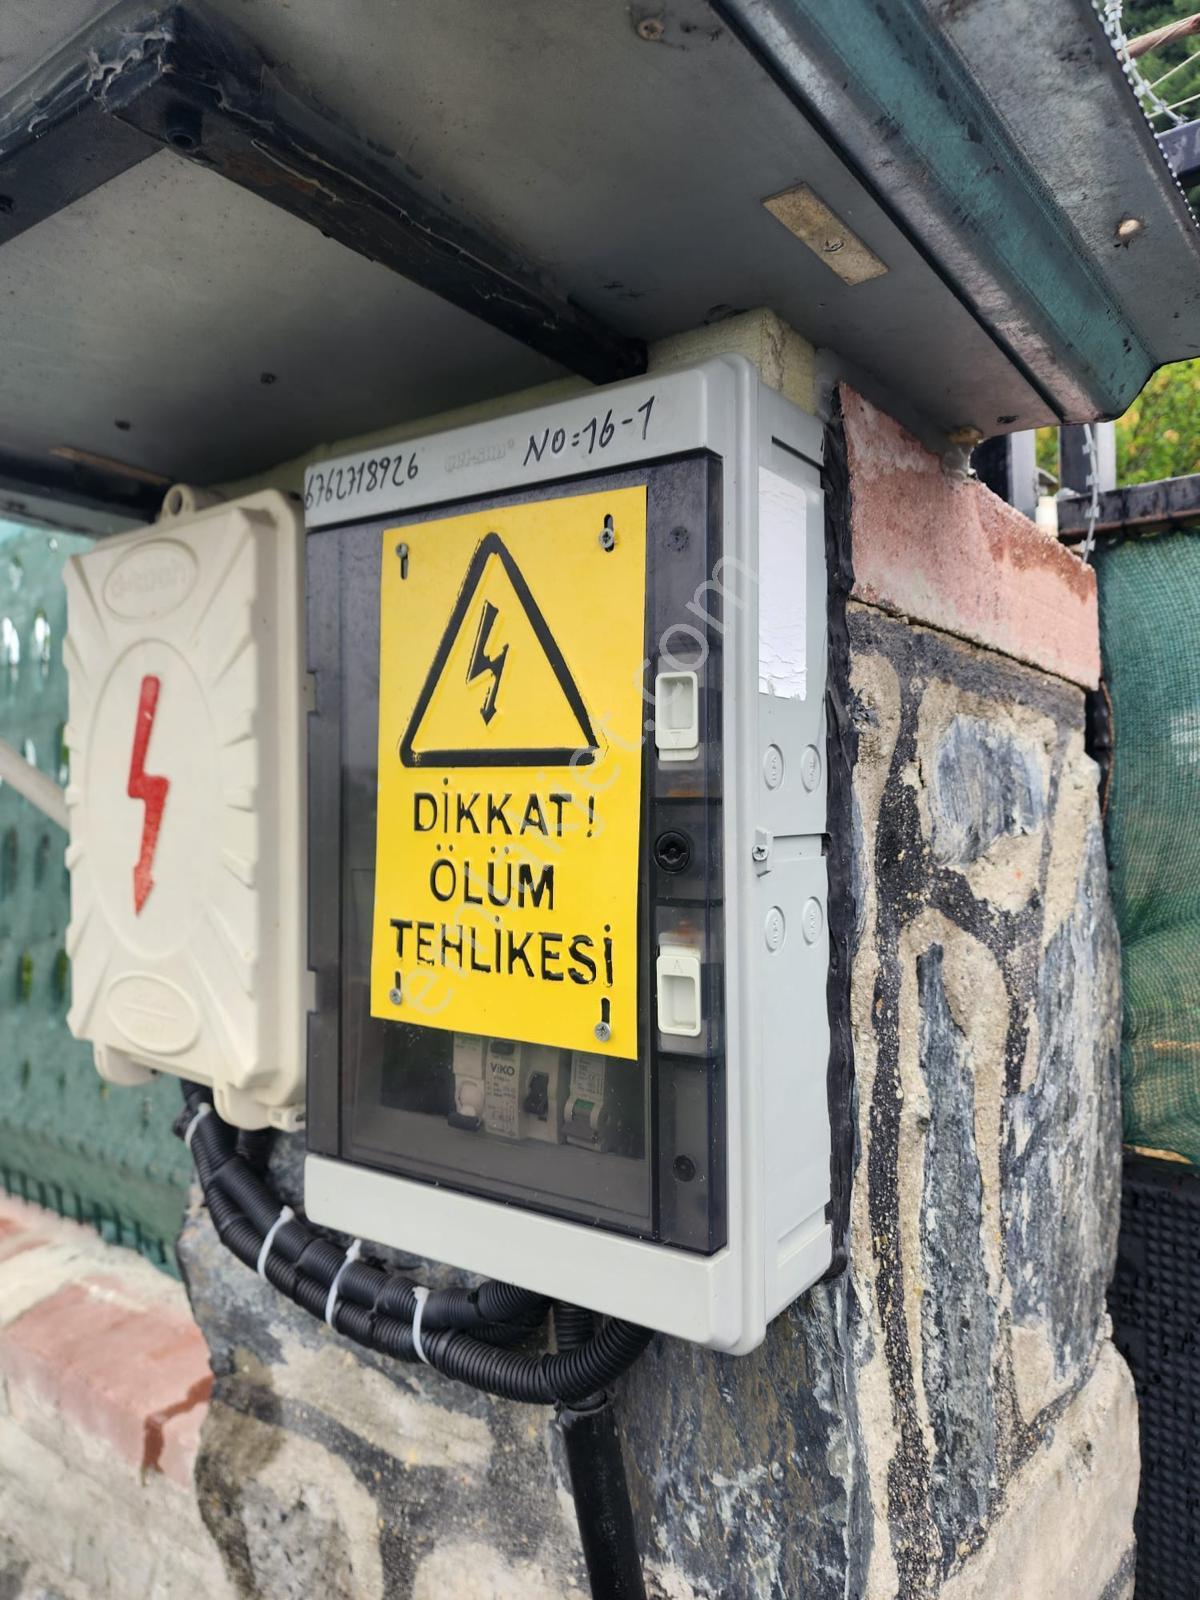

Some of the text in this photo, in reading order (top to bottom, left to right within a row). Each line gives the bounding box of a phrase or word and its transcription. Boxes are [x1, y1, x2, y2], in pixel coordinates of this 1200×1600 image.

[413, 777, 572, 837] DİKKAT
[429, 843, 555, 910] ÖLÜM
[389, 914, 614, 988] TEHLİKESİ
